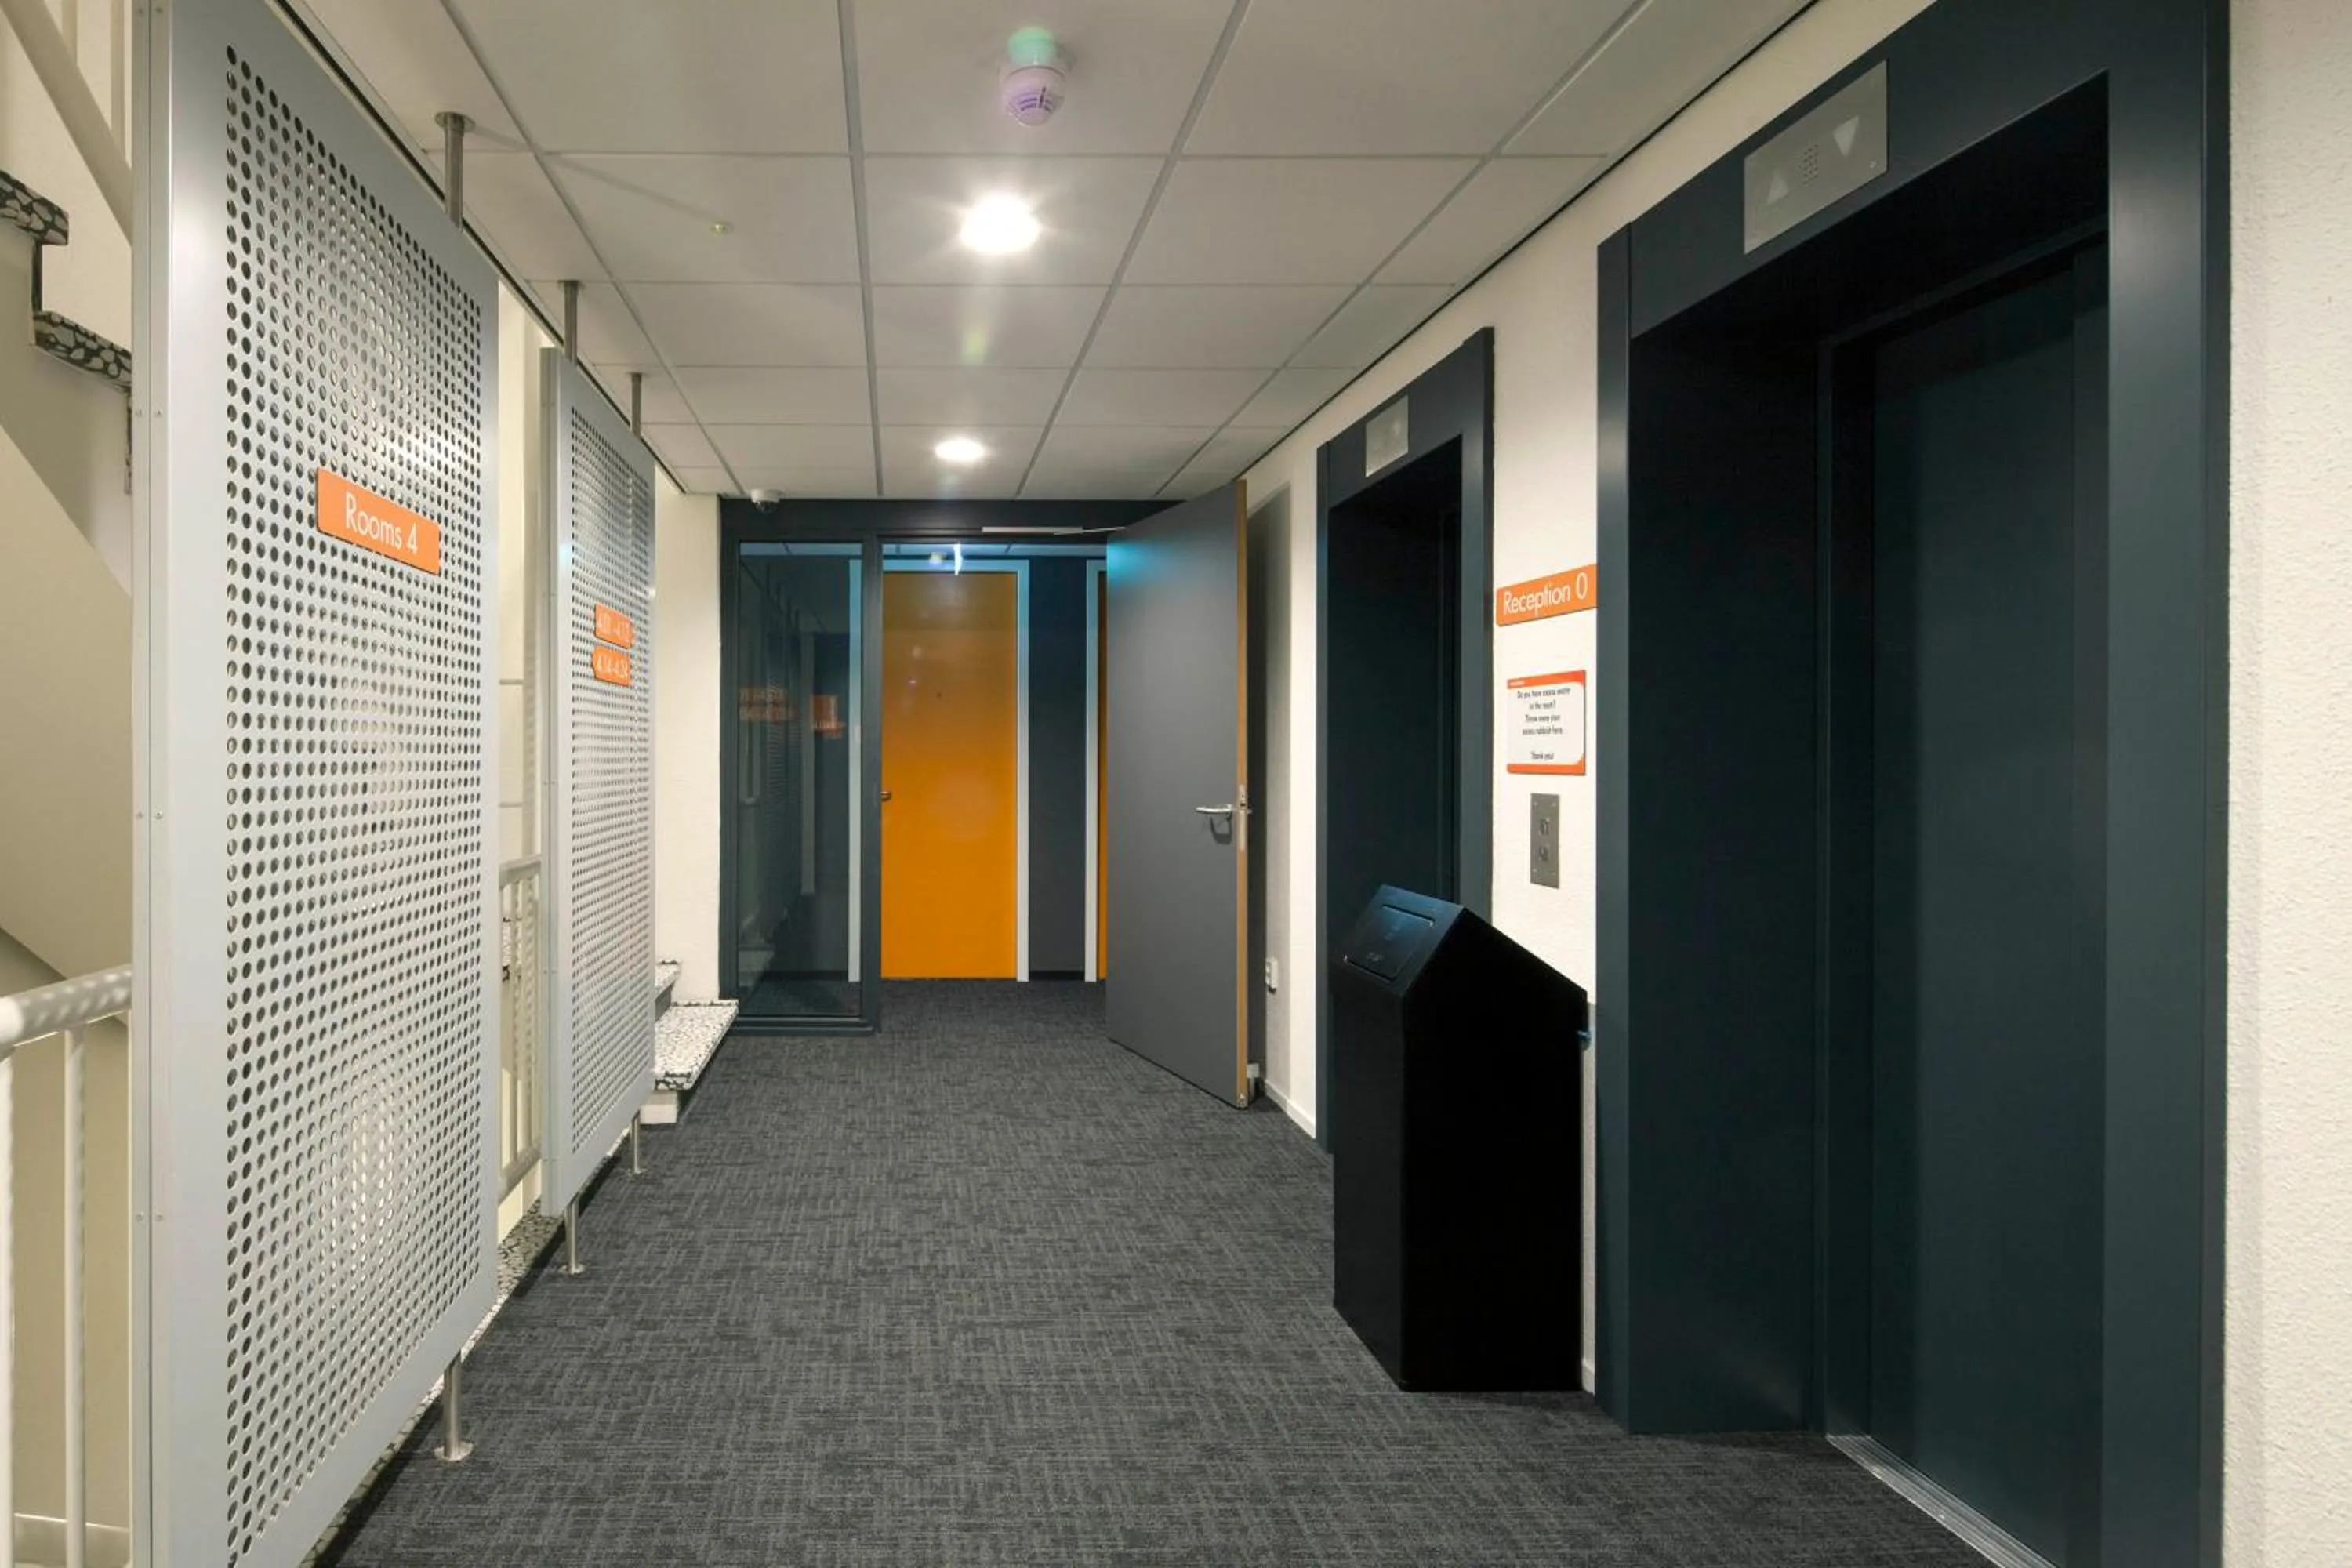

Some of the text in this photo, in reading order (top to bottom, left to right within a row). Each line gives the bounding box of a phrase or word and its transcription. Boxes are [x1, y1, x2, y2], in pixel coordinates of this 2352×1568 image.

[345, 492, 419, 555] Rooms 4
[1503, 583, 1571, 617] Reception
